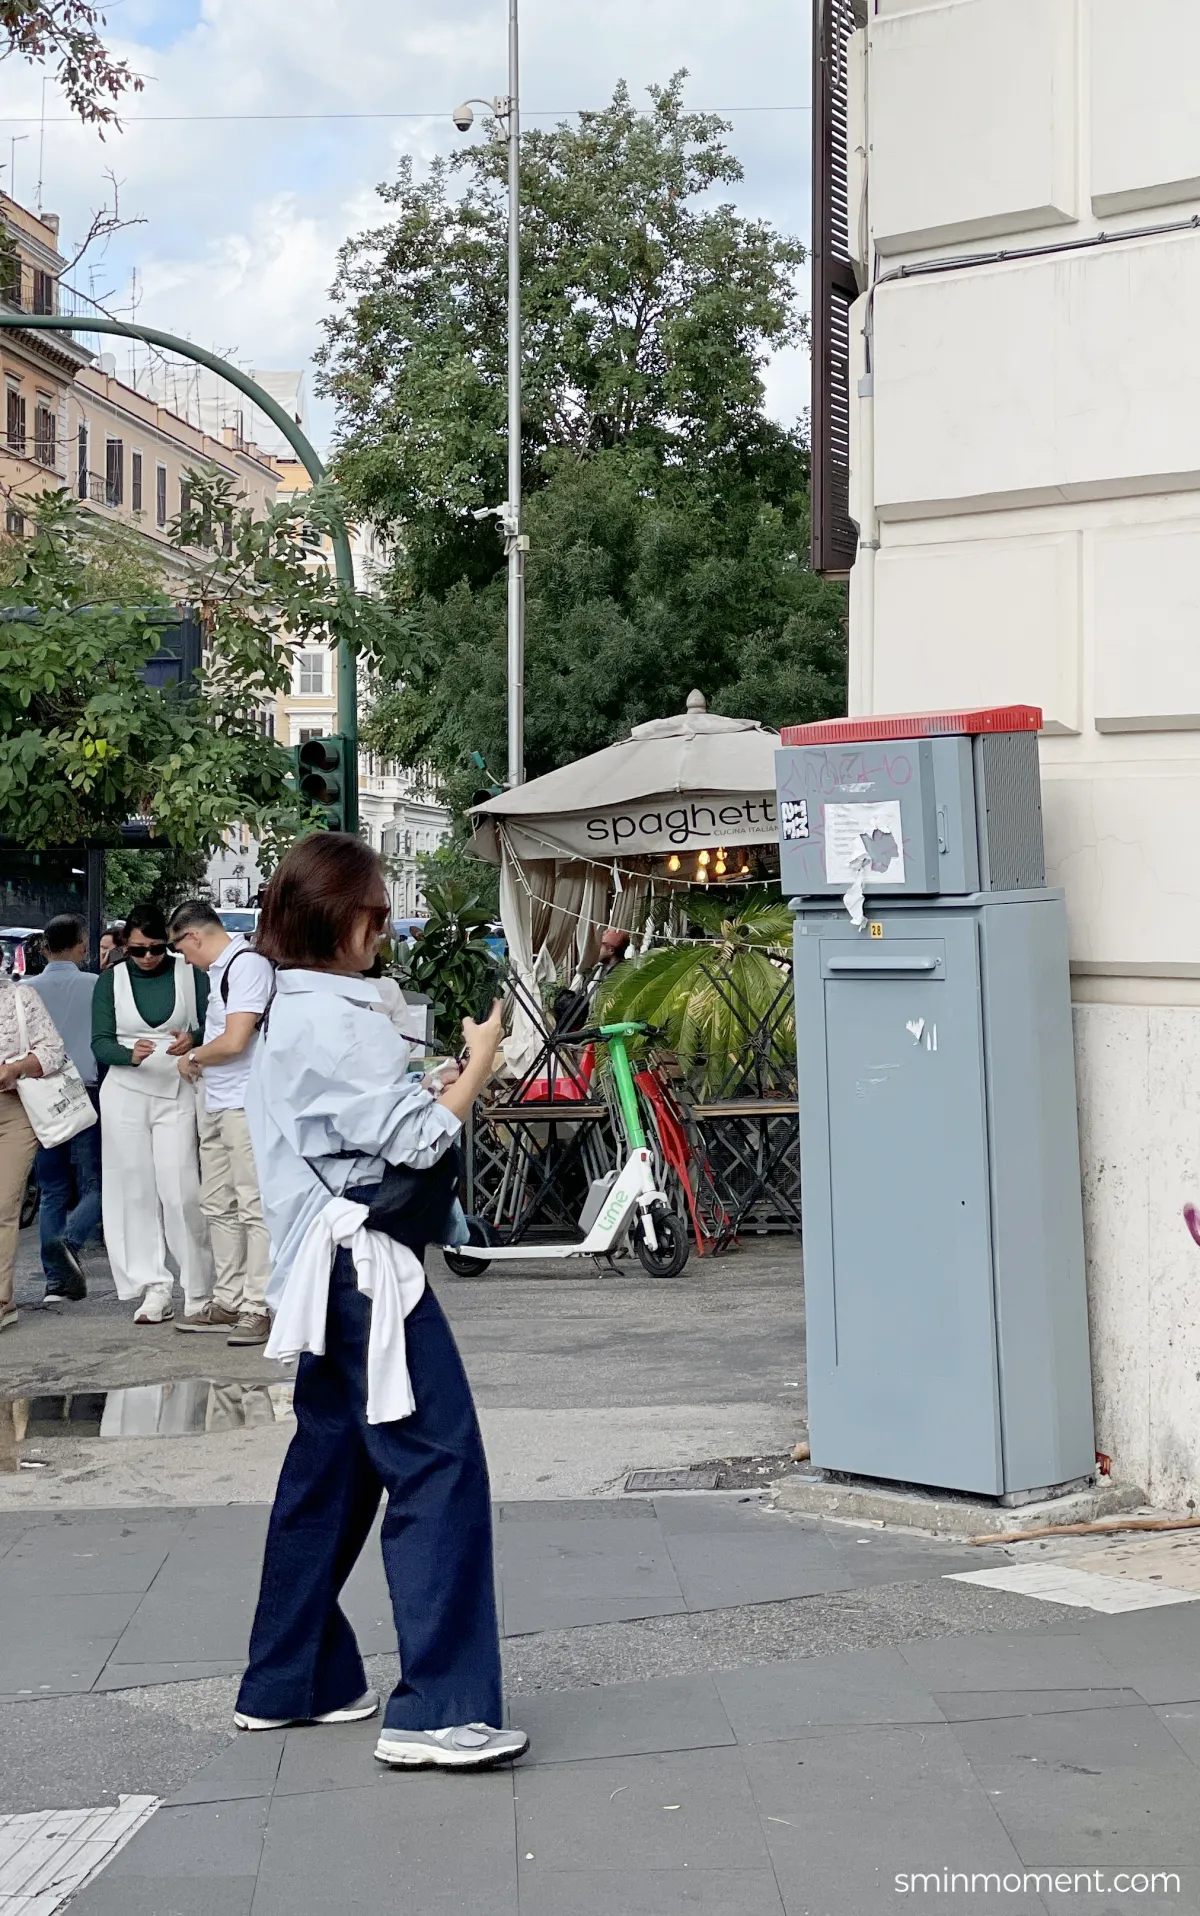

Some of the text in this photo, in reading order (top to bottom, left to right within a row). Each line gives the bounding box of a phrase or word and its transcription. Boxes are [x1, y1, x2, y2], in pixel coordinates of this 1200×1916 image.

[713, 826, 747, 836] CUCINA
[872, 925, 882, 936] 28
[598, 1190, 629, 1231] Lime
